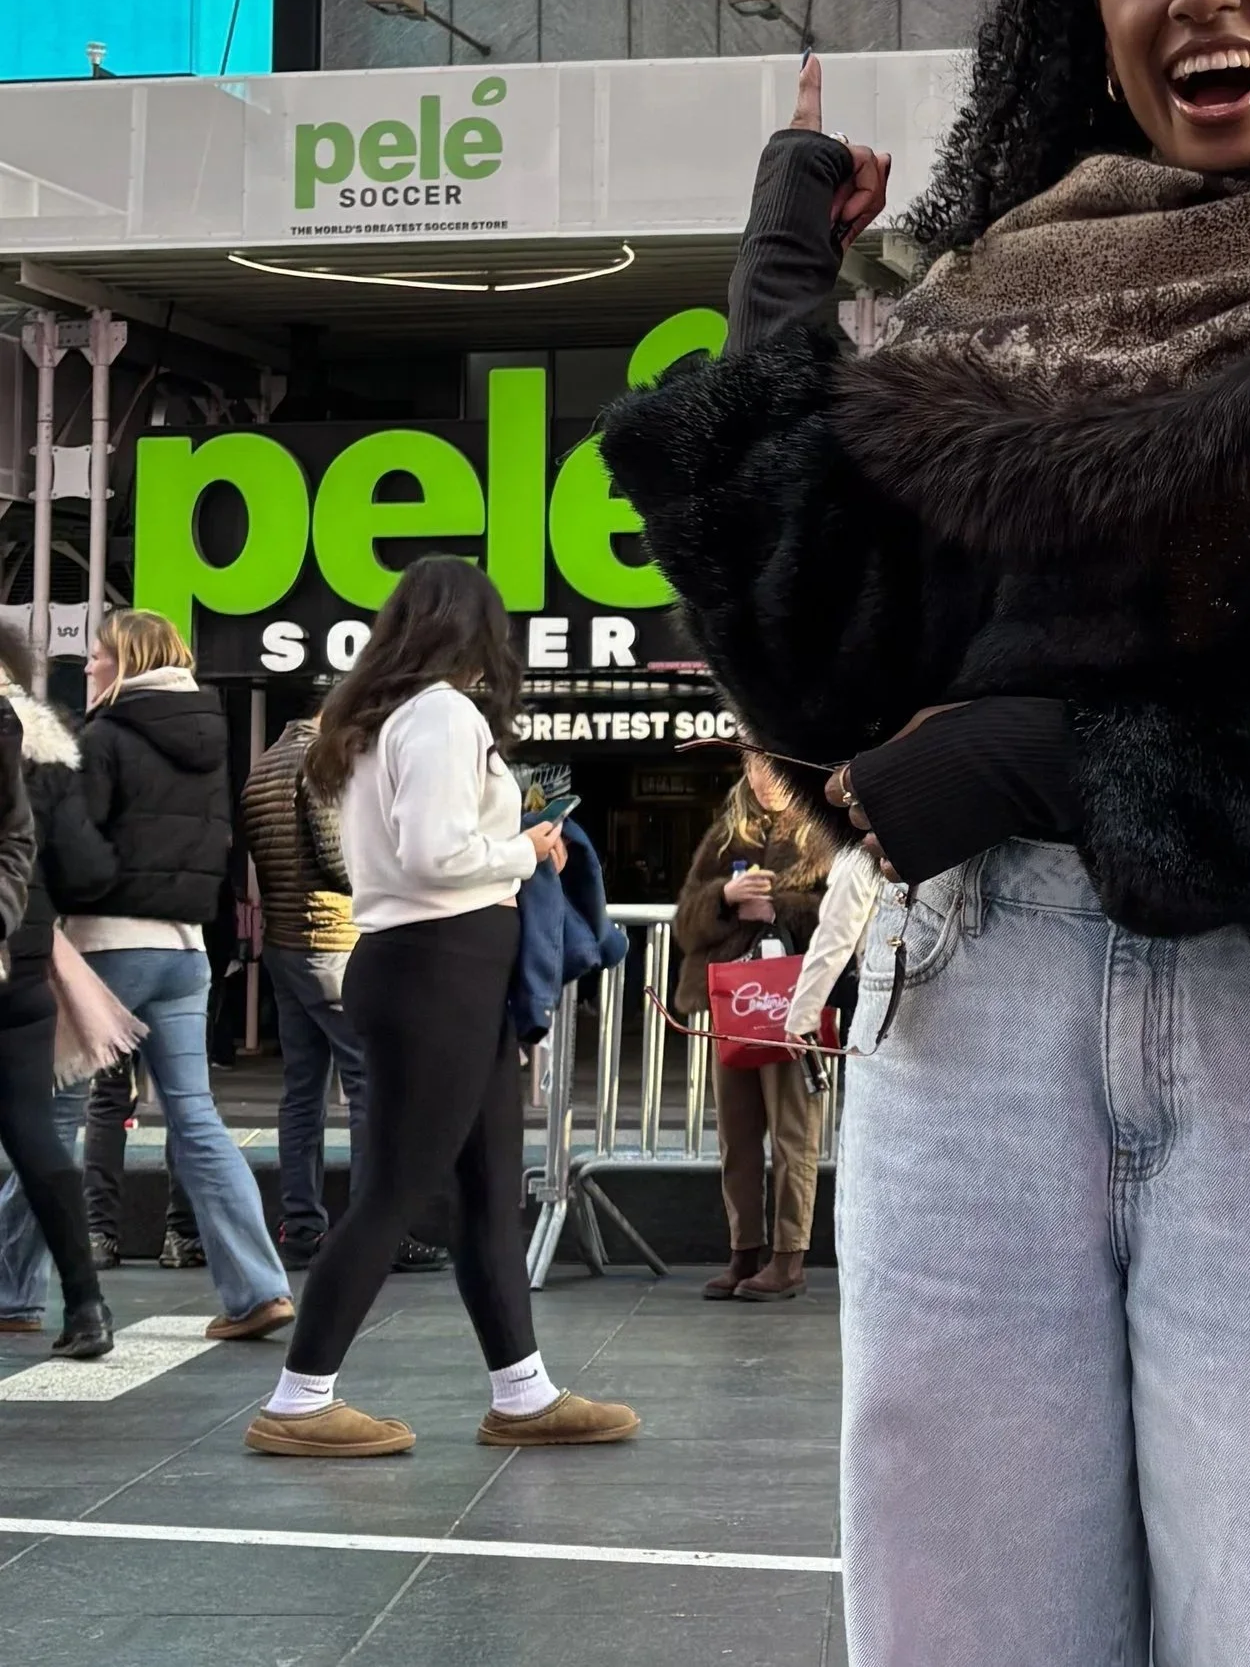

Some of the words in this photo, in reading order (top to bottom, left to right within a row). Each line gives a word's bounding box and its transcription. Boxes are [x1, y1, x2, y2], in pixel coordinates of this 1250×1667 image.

[294, 76, 508, 210] pelé
[338, 184, 463, 209] SOCCER
[291, 226, 312, 236] THE
[315, 224, 363, 235] WORLD'S
[364, 222, 422, 234] GREATEST
[424, 220, 469, 232] SOCCER
[471, 219, 509, 231] STORE
[260, 616, 637, 672] SOER
